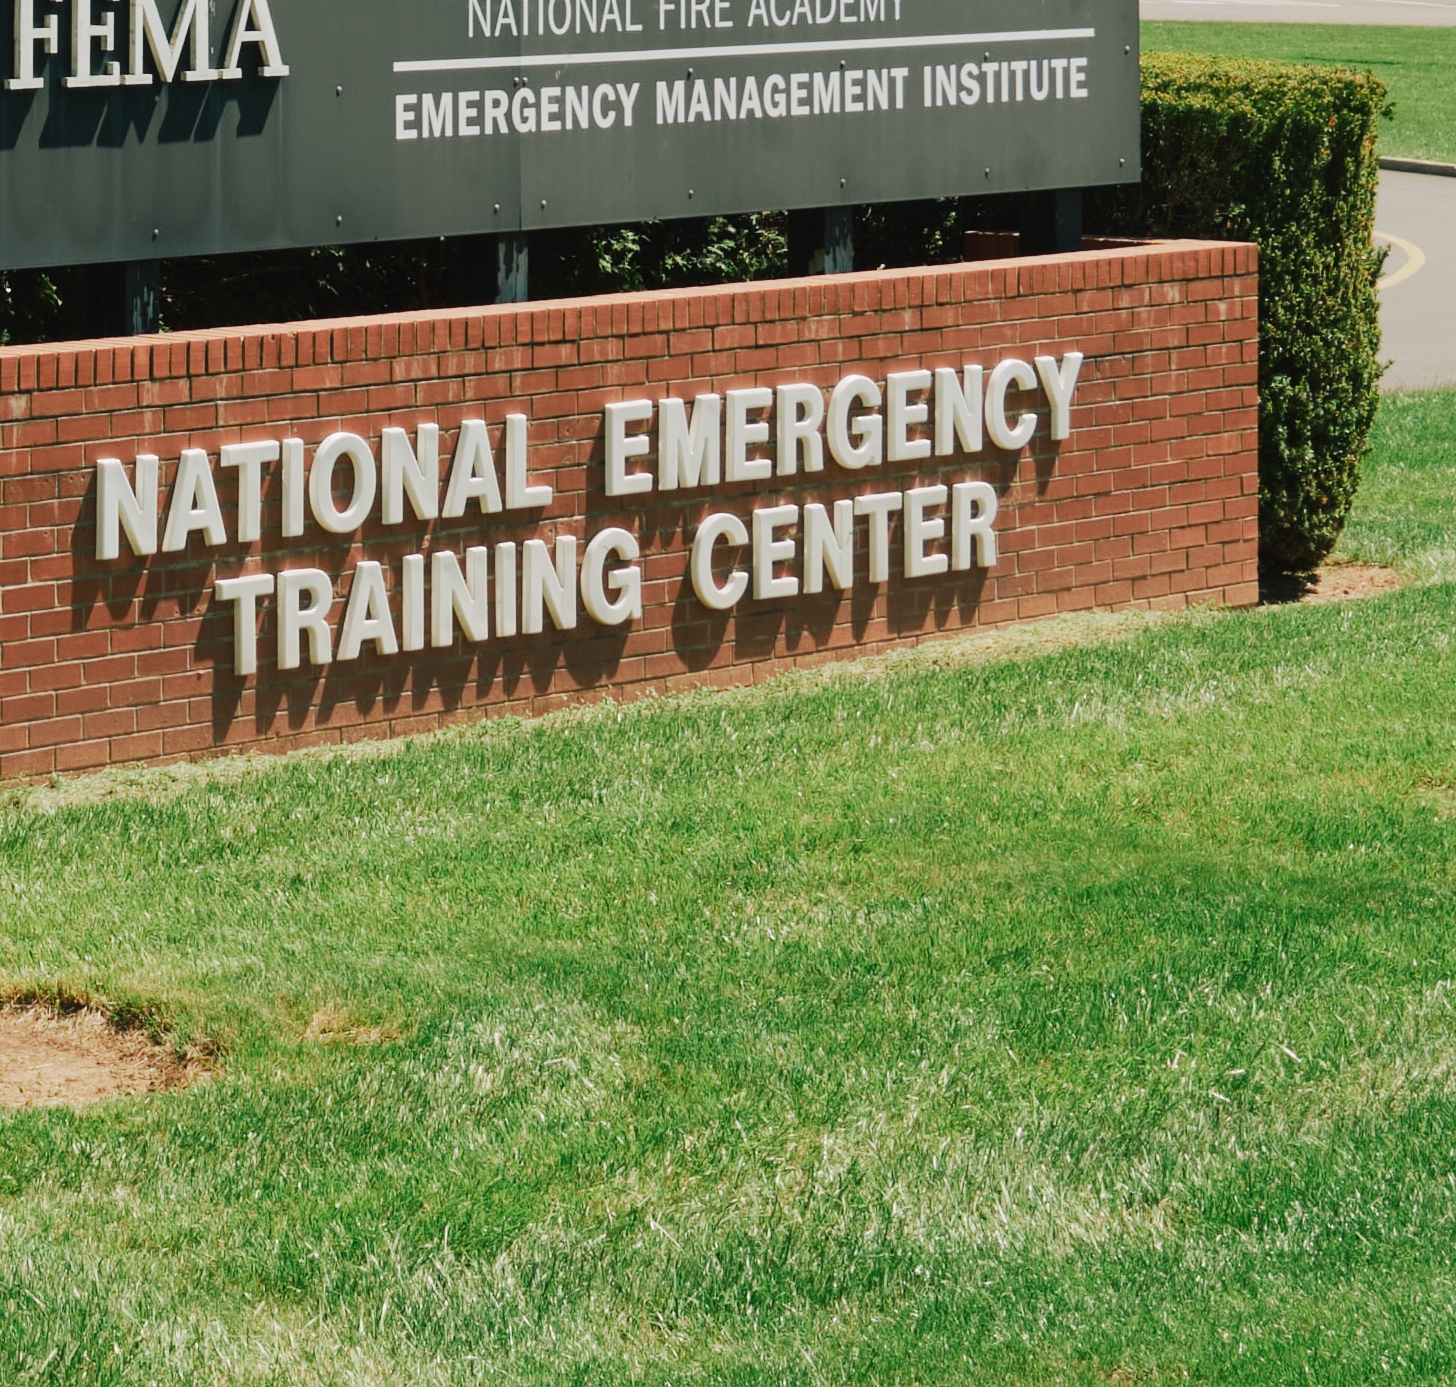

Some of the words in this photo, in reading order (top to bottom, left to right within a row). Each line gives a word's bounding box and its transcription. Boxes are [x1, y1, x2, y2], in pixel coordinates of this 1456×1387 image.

[395, 82, 641, 140] EMERGENCY
[655, 67, 909, 125] MANAGEMENT
[923, 56, 1089, 108] INSTITUTE
[95, 413, 553, 561] NATIONAL
[604, 351, 1084, 497] EMERGENCY
[214, 527, 642, 677] TRAINING
[690, 480, 999, 611] CENTER
